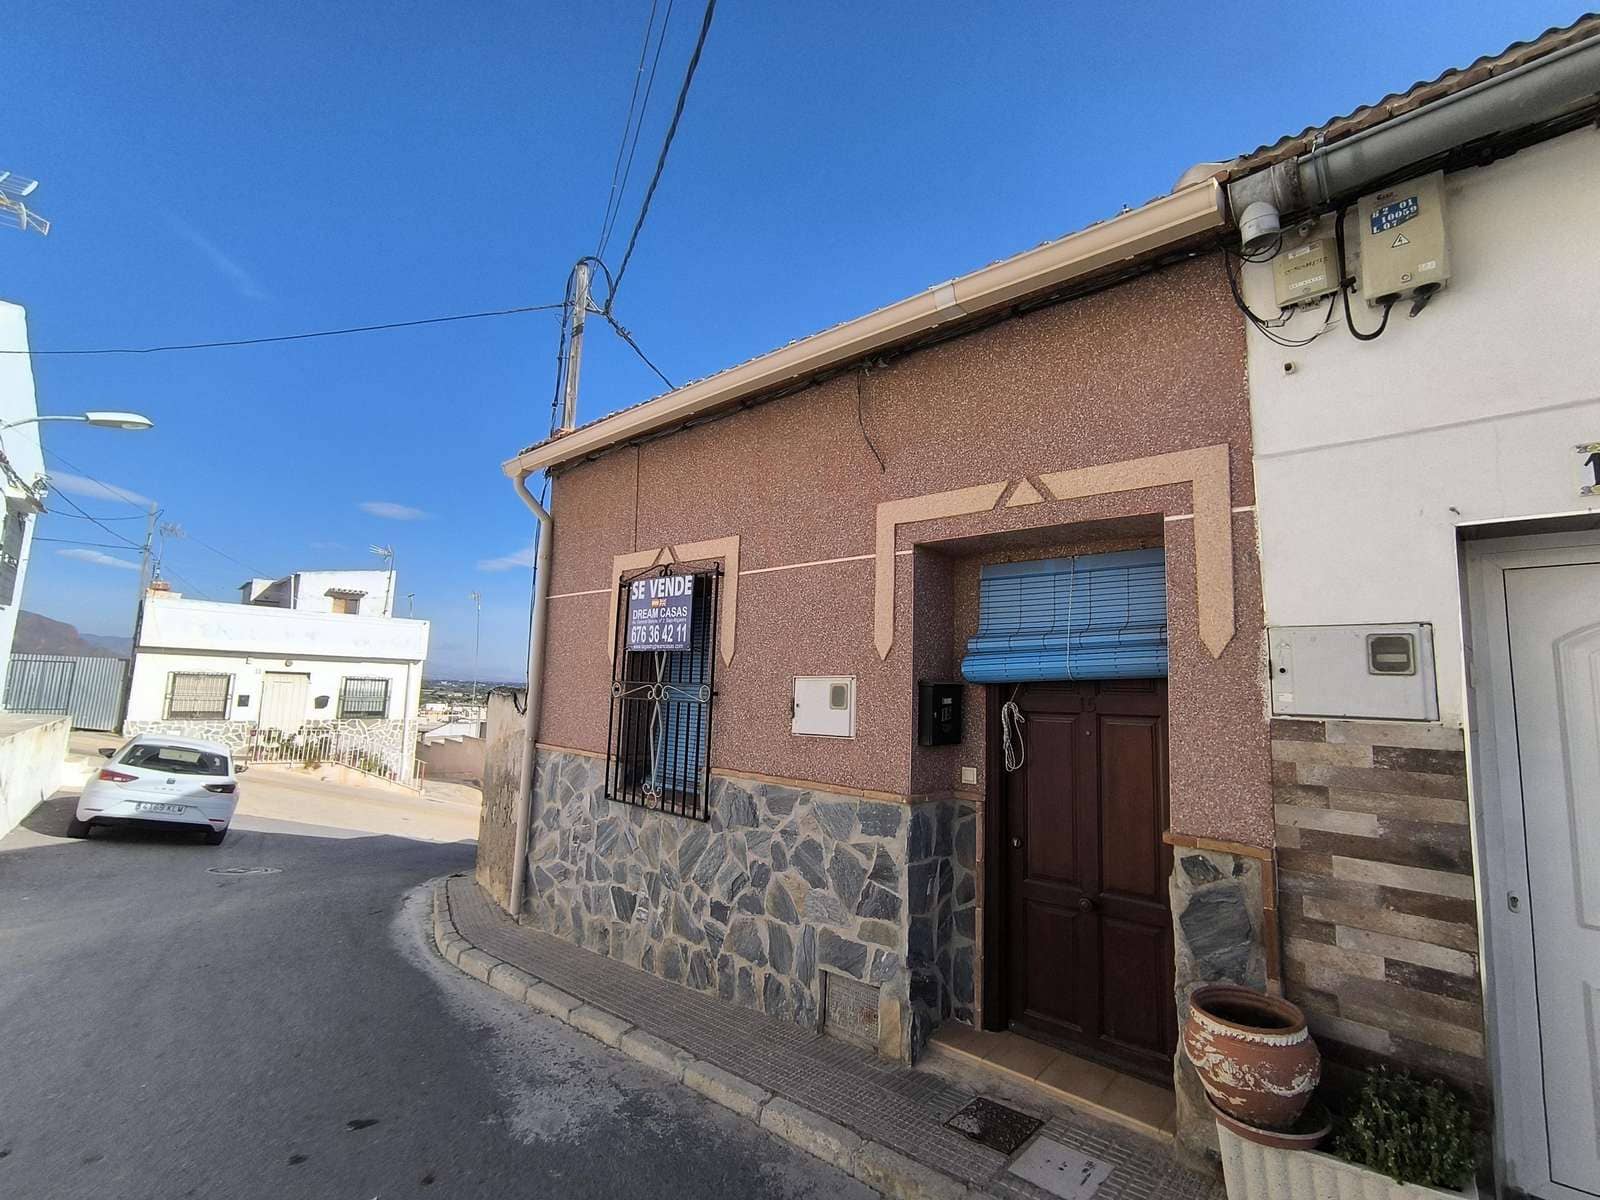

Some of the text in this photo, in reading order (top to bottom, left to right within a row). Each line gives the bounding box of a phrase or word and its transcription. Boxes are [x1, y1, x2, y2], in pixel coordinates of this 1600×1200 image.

[632, 576, 692, 600] SE VENDE
[633, 606, 688, 619] DREAM CASAS
[631, 623, 687, 643] 676 36 42 11
